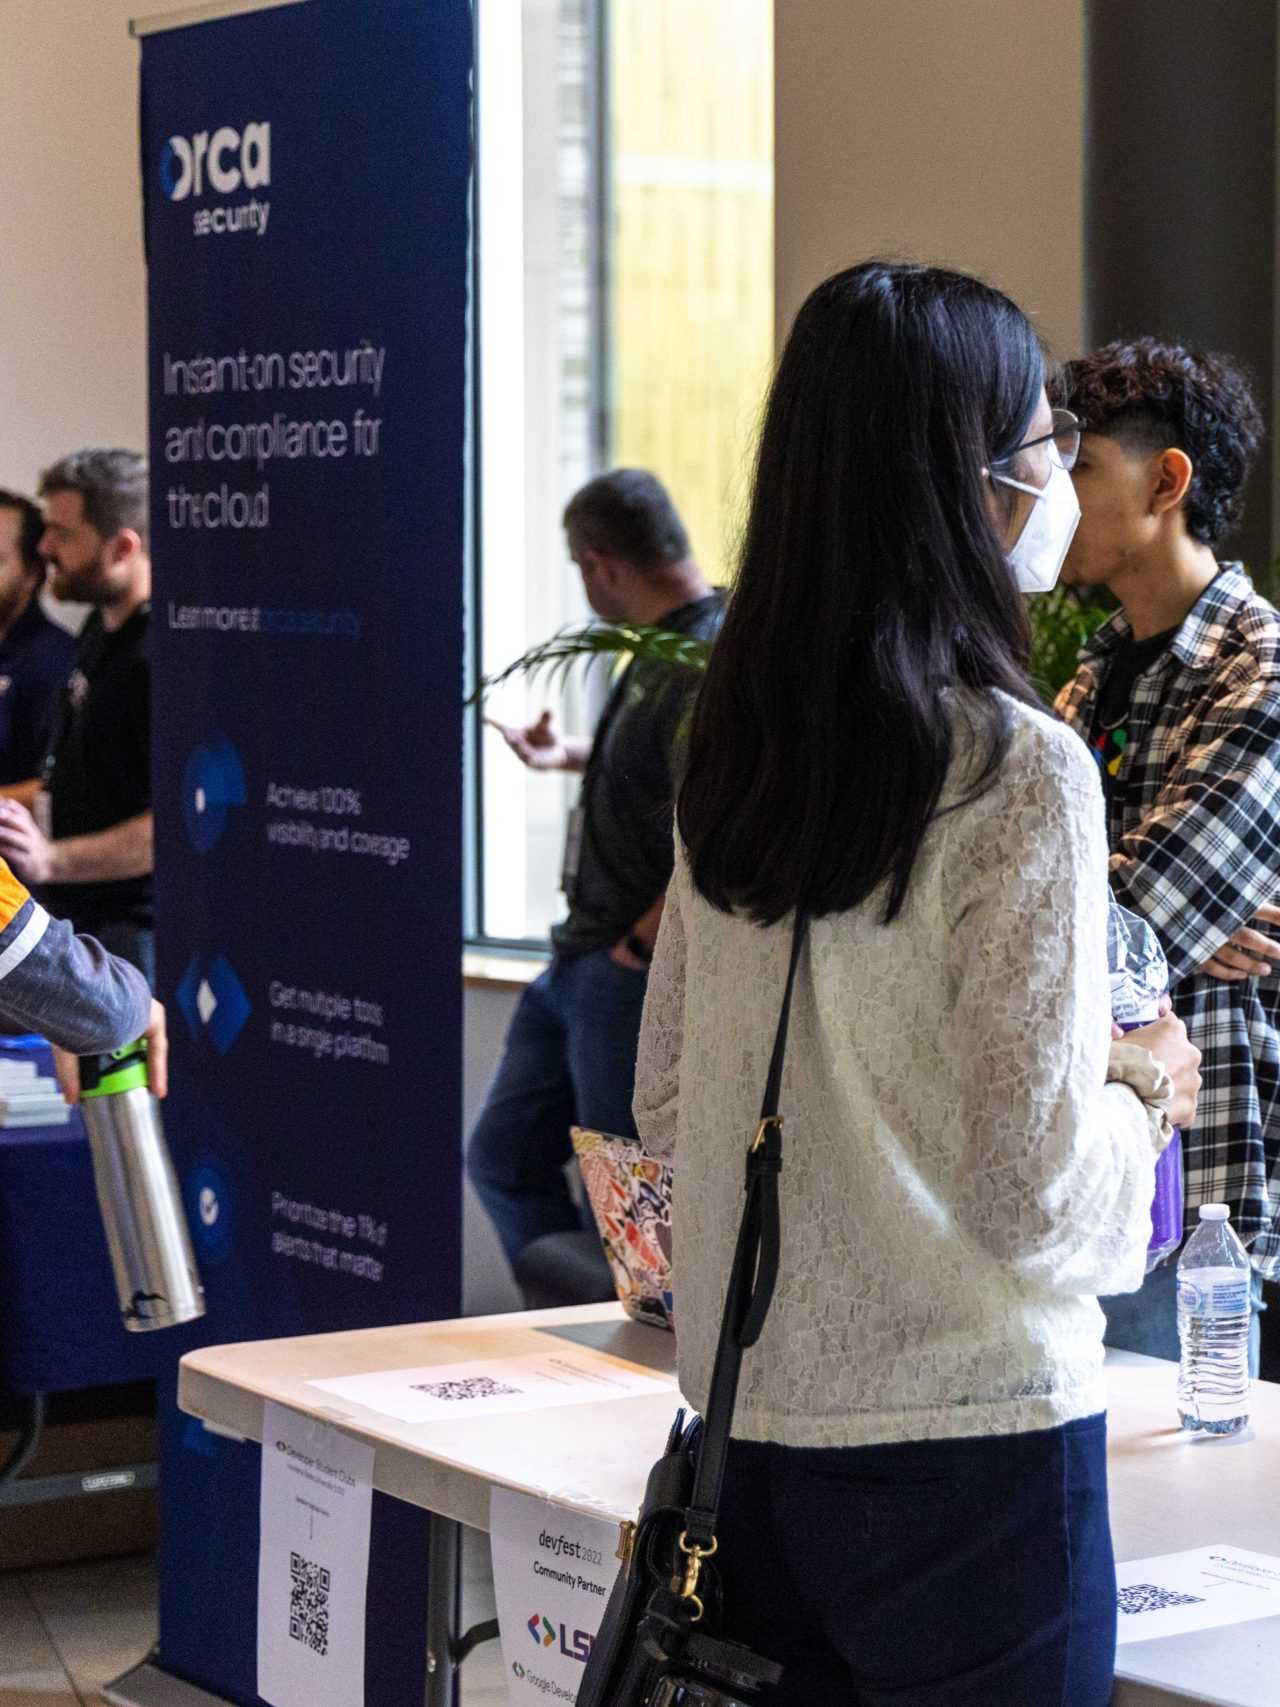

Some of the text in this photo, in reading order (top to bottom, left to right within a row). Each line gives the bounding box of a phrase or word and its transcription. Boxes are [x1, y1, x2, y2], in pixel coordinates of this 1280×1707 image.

[160, 121, 271, 200] orca
[193, 199, 270, 235] security
[538, 1529, 582, 1559] devfest
[533, 1560, 606, 1597] Community Partner
[560, 1623, 597, 1663] LS
